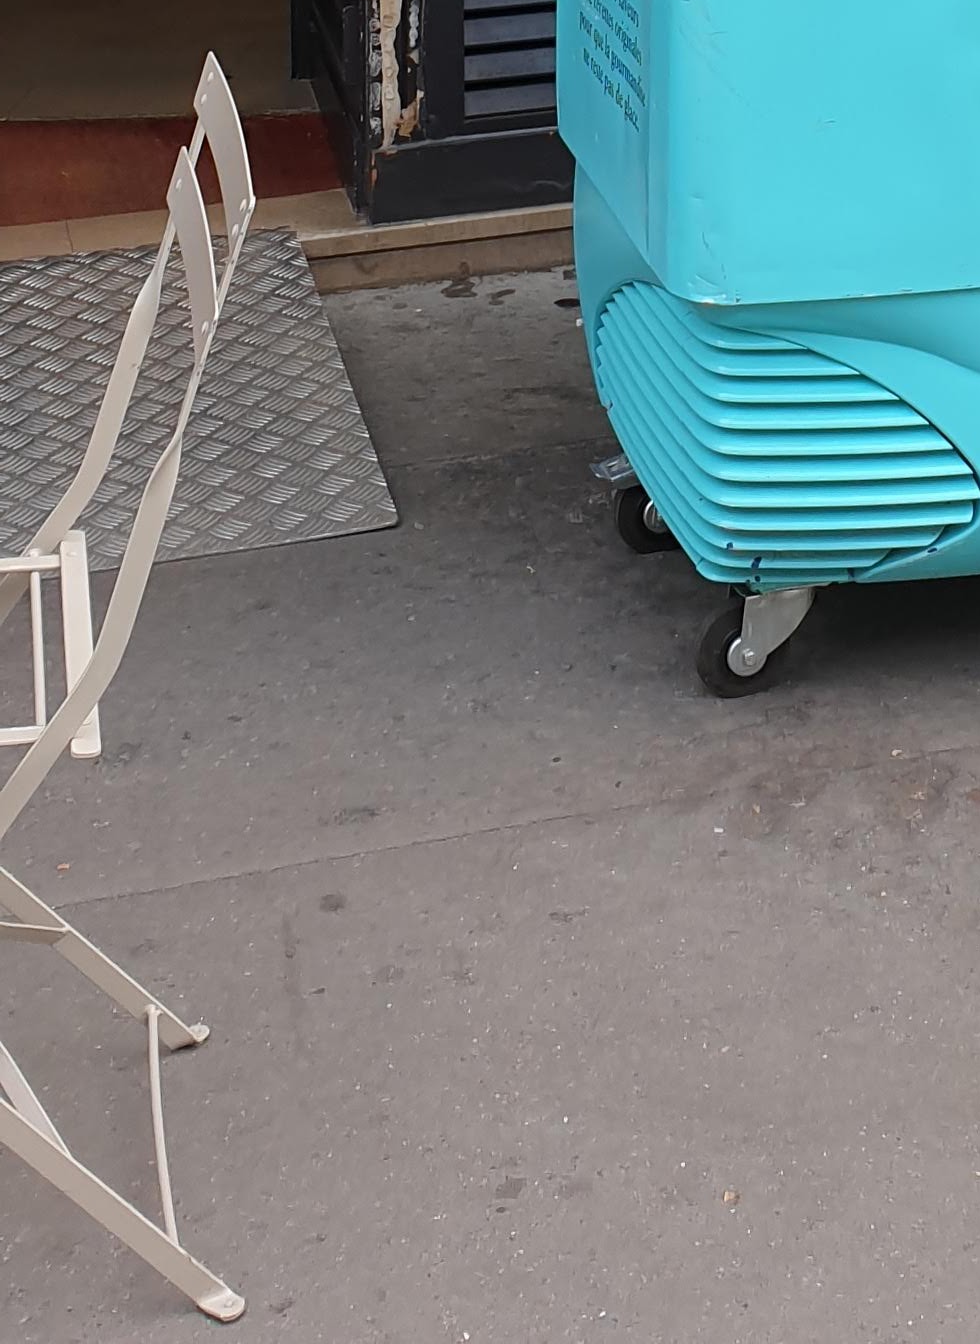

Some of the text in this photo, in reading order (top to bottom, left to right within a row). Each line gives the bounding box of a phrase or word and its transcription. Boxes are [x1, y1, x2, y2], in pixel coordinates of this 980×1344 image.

[579, 10, 592, 37] pour
[604, 32, 611, 60] la
[614, 20, 643, 66] originales
